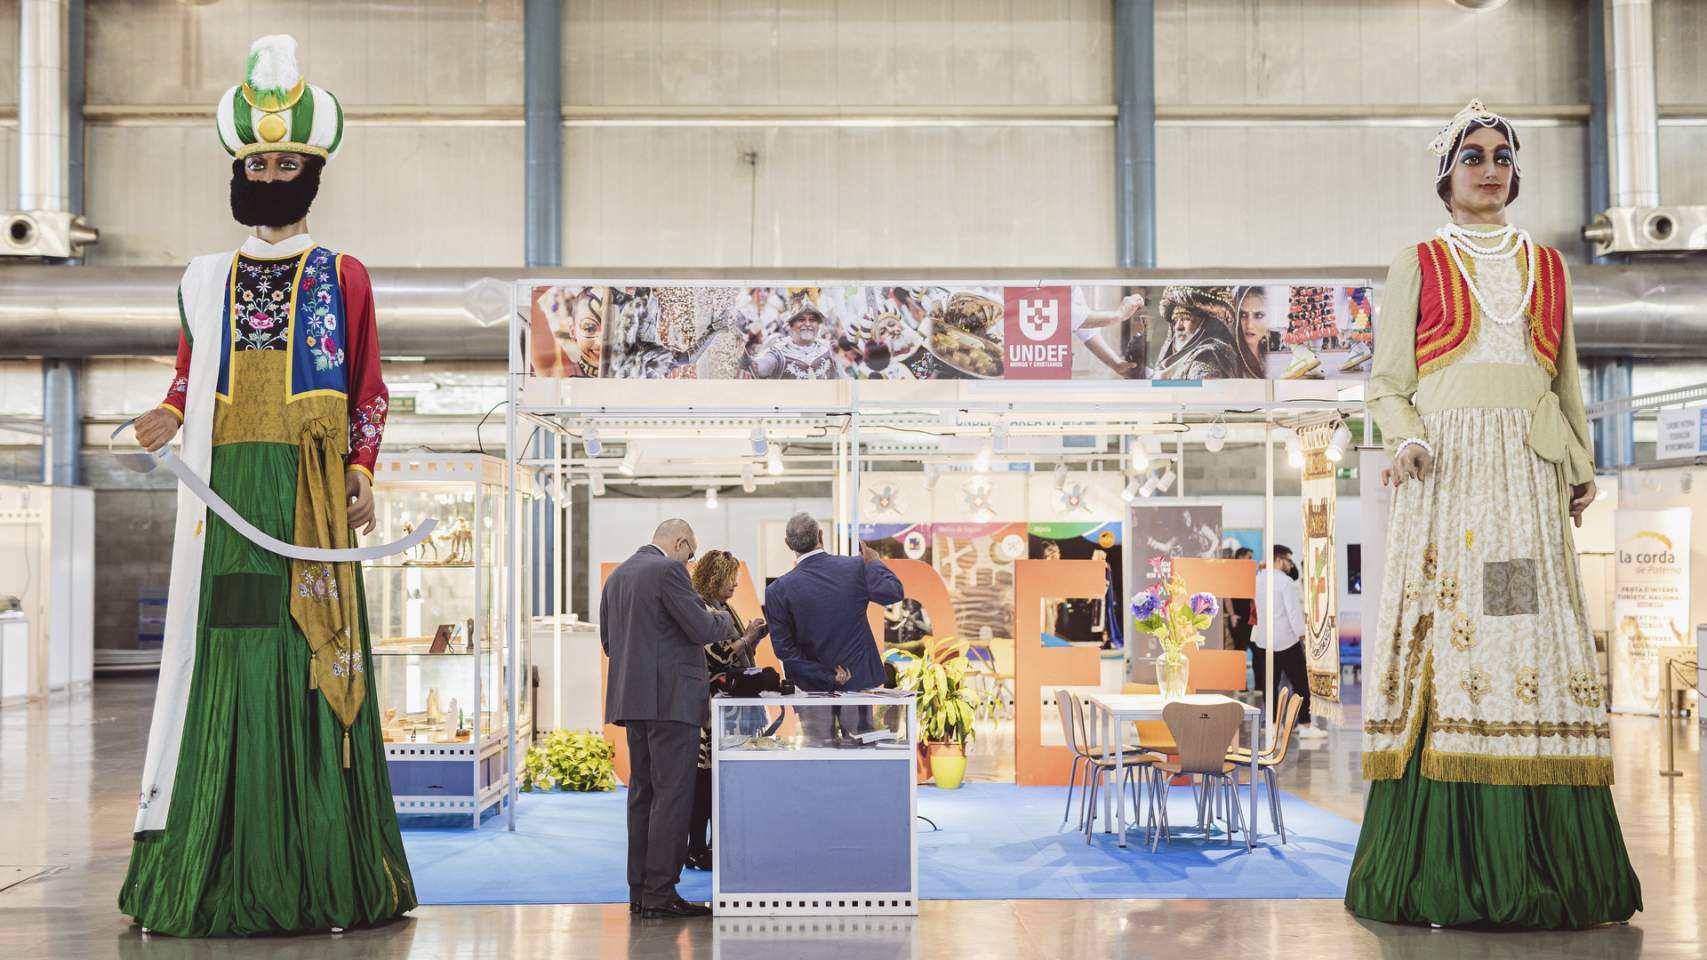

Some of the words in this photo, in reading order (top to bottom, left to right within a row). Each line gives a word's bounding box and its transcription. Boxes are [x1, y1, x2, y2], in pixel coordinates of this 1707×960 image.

[1009, 344, 1068, 362] UNDEF
[1619, 550, 1632, 563] la
[1636, 550, 1675, 564] corda
